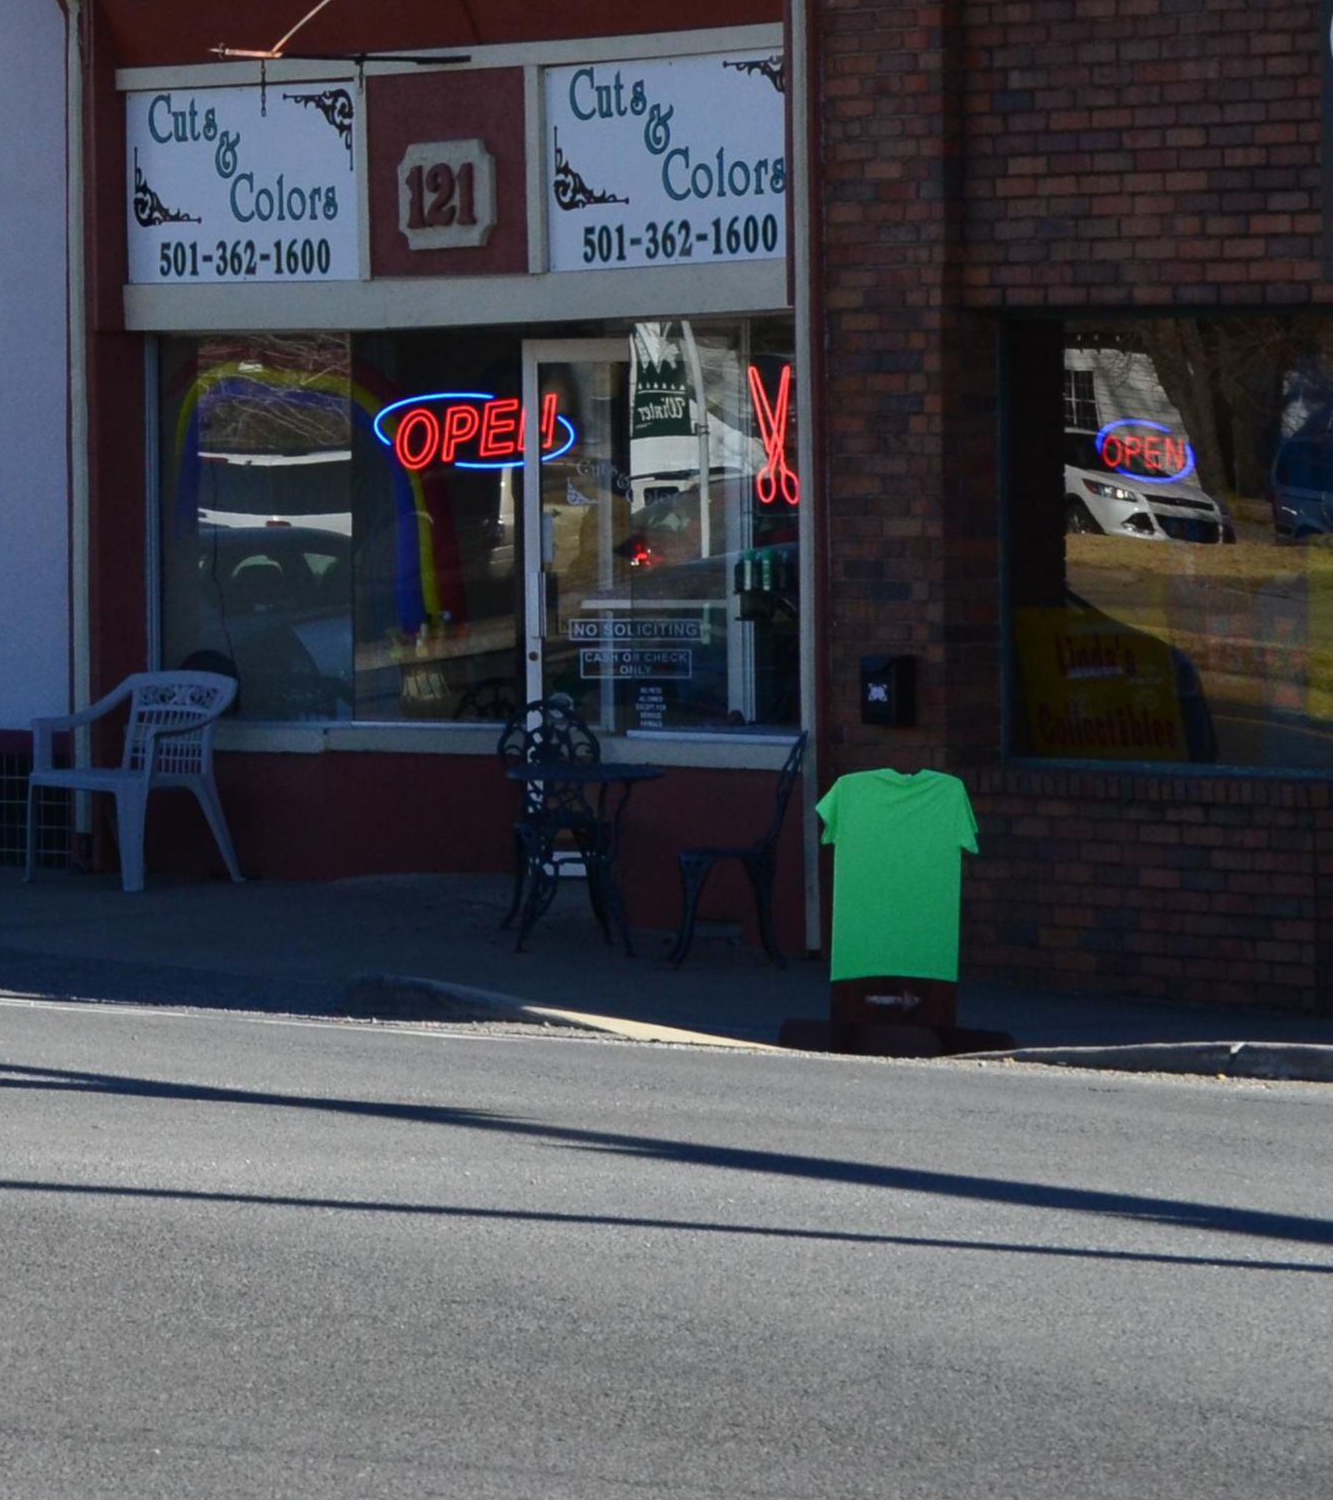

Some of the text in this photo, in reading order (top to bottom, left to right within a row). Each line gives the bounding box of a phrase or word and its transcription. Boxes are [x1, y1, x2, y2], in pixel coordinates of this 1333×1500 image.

[148, 93, 217, 143] Cuts
[569, 66, 647, 121] Cuts
[644, 103, 674, 155] &
[216, 131, 240, 179] &
[662, 146, 786, 201] Colors
[230, 172, 338, 223] Colors
[405, 162, 475, 230] 121
[160, 238, 331, 276] 501-362-1600
[583, 213, 778, 263] 501-362-1600
[1102, 434, 1185, 470] OPEN
[573, 622, 698, 637] NO SOLICITING
